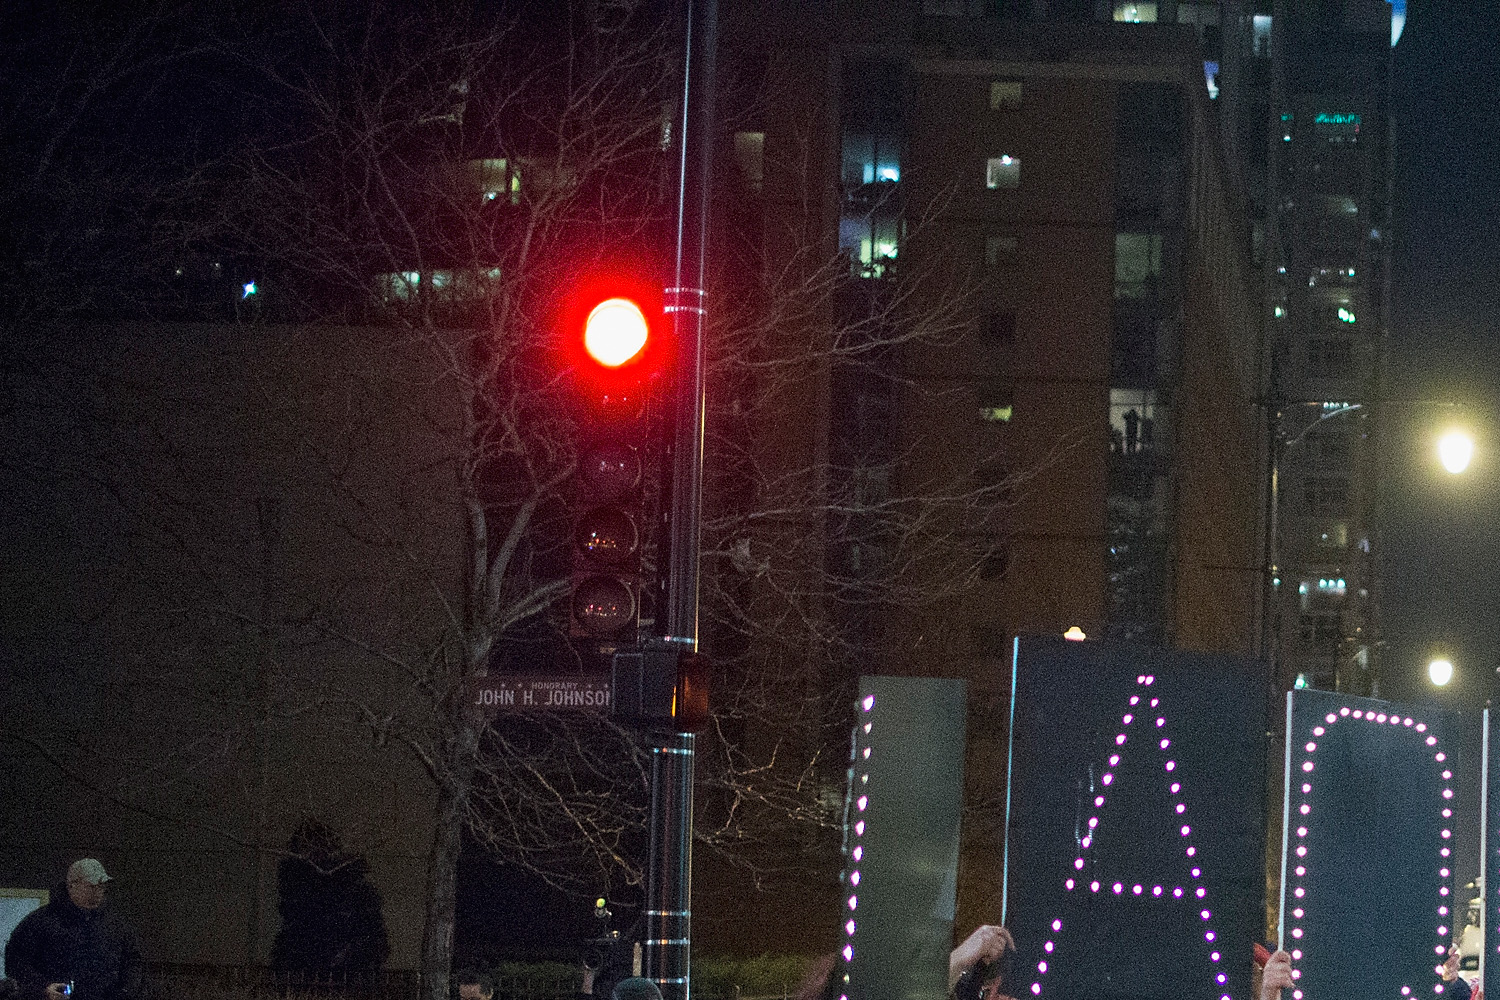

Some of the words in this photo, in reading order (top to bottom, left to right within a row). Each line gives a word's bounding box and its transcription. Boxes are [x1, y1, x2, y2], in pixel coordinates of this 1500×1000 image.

[531, 682, 578, 690] HONORARY
[474, 689, 514, 705] JOHN
[523, 690, 539, 705] H.
